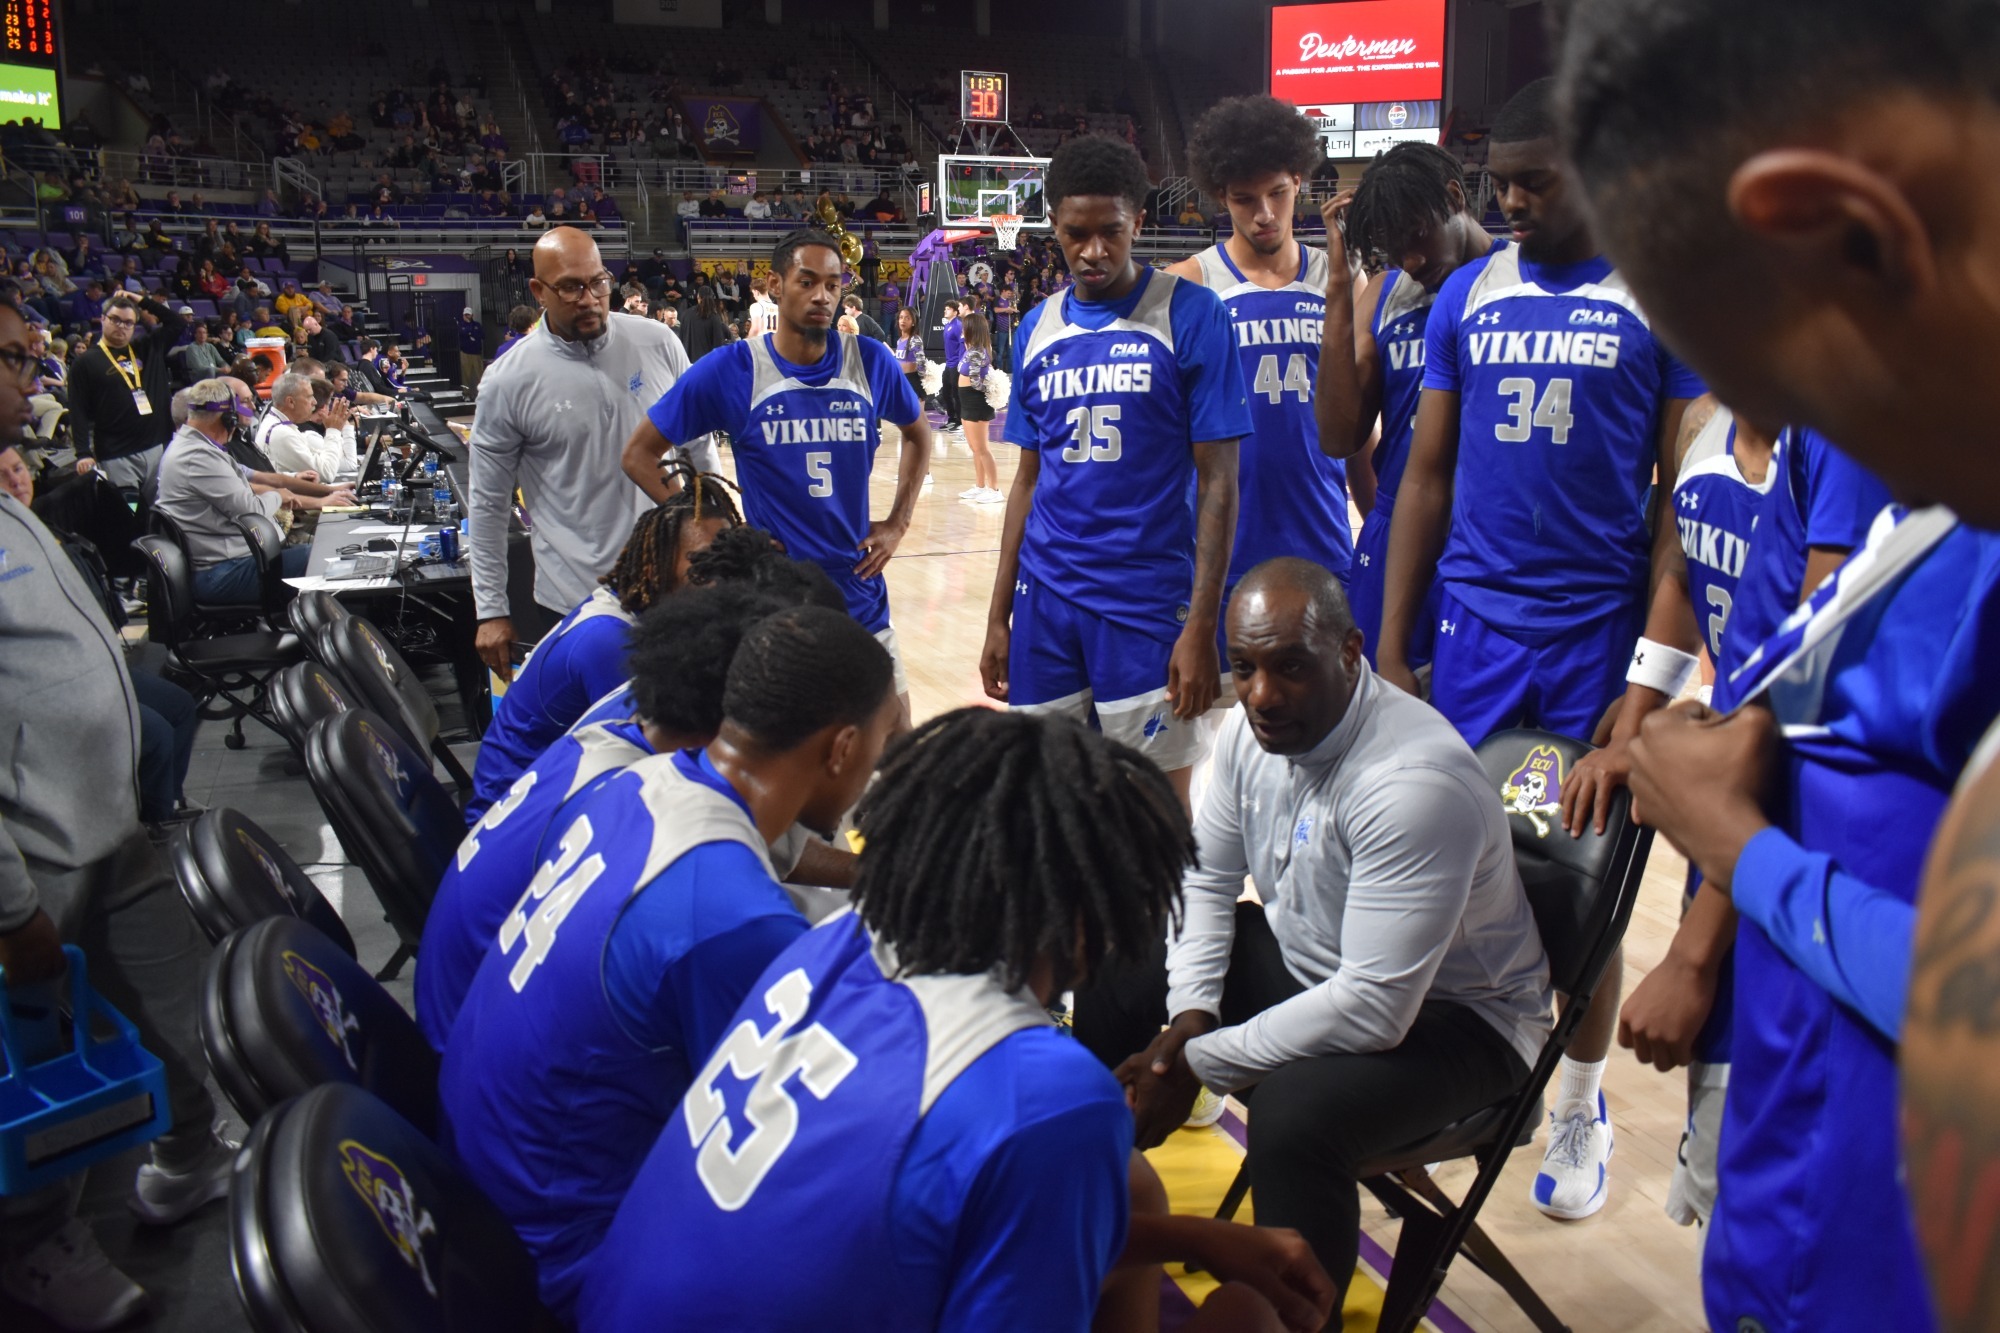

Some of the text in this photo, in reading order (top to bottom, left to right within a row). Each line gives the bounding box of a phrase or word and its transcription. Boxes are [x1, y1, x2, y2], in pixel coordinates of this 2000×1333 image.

[6, 14, 19, 26] 23
[46, 21, 51, 30] 1
[8, 4, 18, 12] 11
[42, 8, 50, 18] 2
[6, 26, 52, 42] 24 1 3
[8, 38, 22, 50] 25
[1299, 32, 1416, 62] Deuterman
[1372, 63, 1414, 71] EXPERIENCE
[969, 77, 1002, 91] 11:37
[970, 91, 998, 118] 30
[69, 210, 84, 220] 101
[766, 314, 777, 330] 11
[1568, 308, 1619, 328] CIAA
[1232, 318, 1325, 348] IKINGS
[1110, 344, 1150, 358] CIAA
[1469, 331, 1620, 368] VIKINGS
[1038, 363, 1152, 402] VIKINGS
[1254, 354, 1310, 404] 44
[829, 402, 862, 413] CIAA
[1495, 378, 1574, 445] 34
[761, 418, 866, 445] VIKINGS
[1062, 404, 1122, 463] 35
[806, 452, 833, 498] 5
[1530, 758, 1554, 772] ECU
[500, 814, 606, 994] 24
[684, 968, 858, 1212] 25
